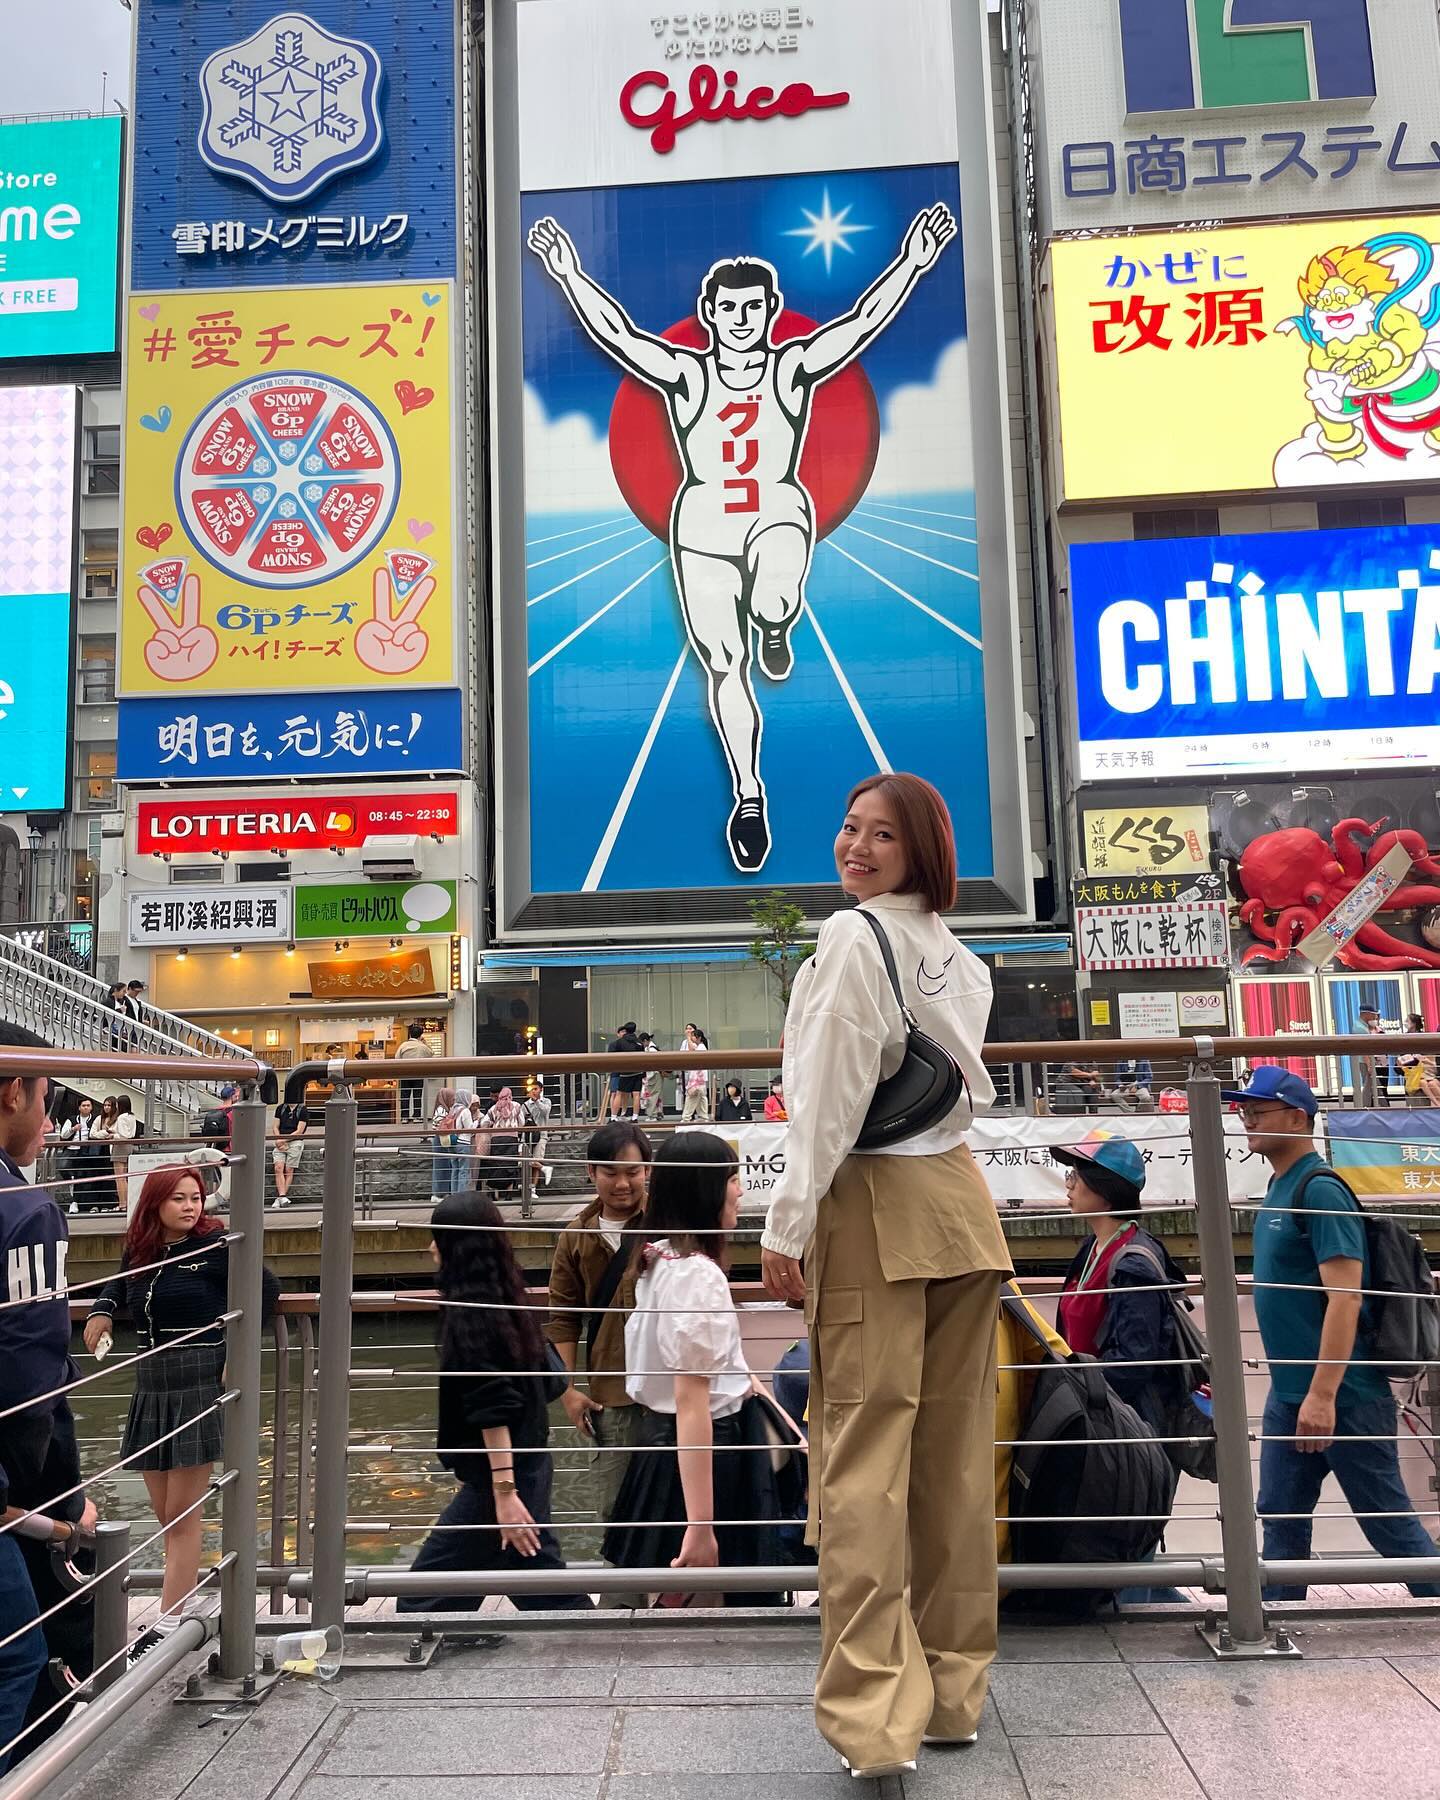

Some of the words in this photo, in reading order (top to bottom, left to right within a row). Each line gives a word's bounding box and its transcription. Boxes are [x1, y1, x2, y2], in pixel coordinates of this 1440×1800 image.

[664, 34, 798, 60] ゆたかな人生
[1062, 122, 1440, 198] 日商エステム
[171, 213, 409, 255] 雪印メグミルク
[1103, 247, 1248, 289] かぜに
[13, 288, 57, 304] FREE
[1088, 287, 1268, 355] 改源
[263, 392, 315, 408] SNOW
[200, 416, 235, 466] SNOW
[272, 428, 304, 437] CHEESE
[342, 414, 378, 460] SNOW
[236, 443, 257, 472] CHEESE
[319, 440, 340, 469] CHEESE
[716, 394, 763, 514] グリコ
[235, 490, 256, 519] CHEESE
[319, 487, 340, 516] CHEESE
[197, 499, 233, 545] SNOW
[272, 523, 304, 531] CHEESE
[342, 493, 377, 543] SNOW
[152, 563, 178, 578] SNOW
[260, 552, 313, 567] SNOW
[396, 556, 423, 568] SNOW
[1095, 750, 1154, 769] 天気予報
[150, 812, 317, 839] LOTTERIA
[1108, 816, 1186, 866] くくる
[1077, 879, 1182, 903] 大阪もんを食す
[1204, 888, 1222, 900] 2F
[342, 896, 398, 923] ピタットハウス
[1086, 913, 1207, 959] 大阪に乾杯
[1211, 918, 1223, 946] 検索
[1289, 1020, 1311, 1032] Street
[1378, 1018, 1401, 1030] Street
